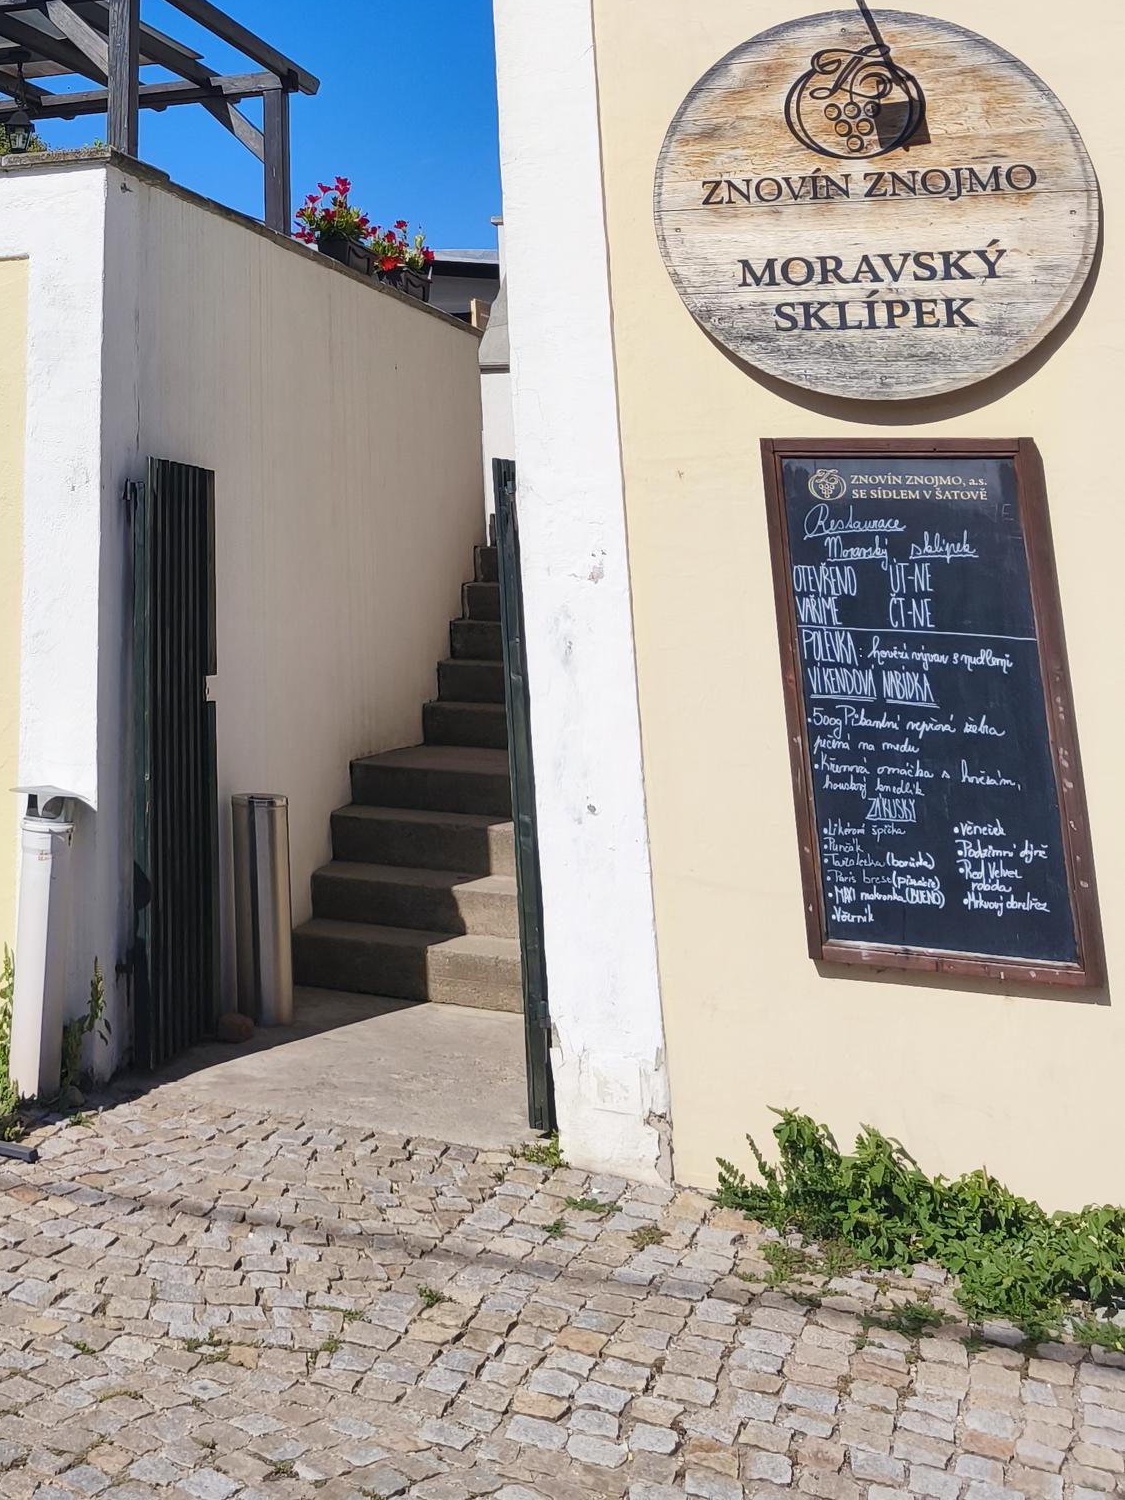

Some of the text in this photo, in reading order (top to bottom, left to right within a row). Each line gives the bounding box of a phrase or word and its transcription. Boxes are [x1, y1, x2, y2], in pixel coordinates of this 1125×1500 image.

[701, 163, 1037, 206] ZNOVÍN ZNOJMO
[737, 239, 1007, 288] MORAVSKÝ
[774, 290, 978, 332] SKLÍPEK
[850, 472, 902, 485] ZNOVÍN
[968, 477, 988, 486] a.s.
[851, 486, 988, 501] SE SÍDLEM V ŠATOVĚ
[803, 503, 907, 538] Restaurace
[824, 534, 889, 571] Moravský
[793, 563, 857, 597] OTEVŘENO
[889, 593, 936, 628] ČT-NE
[807, 664, 935, 704] VÍKENDOVÁ NABÍDKA
[858, 741, 876, 751] na
[882, 737, 920, 753] medu
[876, 759, 935, 778] omáčka
[865, 792, 917, 822] ZÁKUSKY
[960, 818, 1007, 837] Věneček
[827, 869, 857, 884] Paris
[834, 885, 856, 905] MAXI
